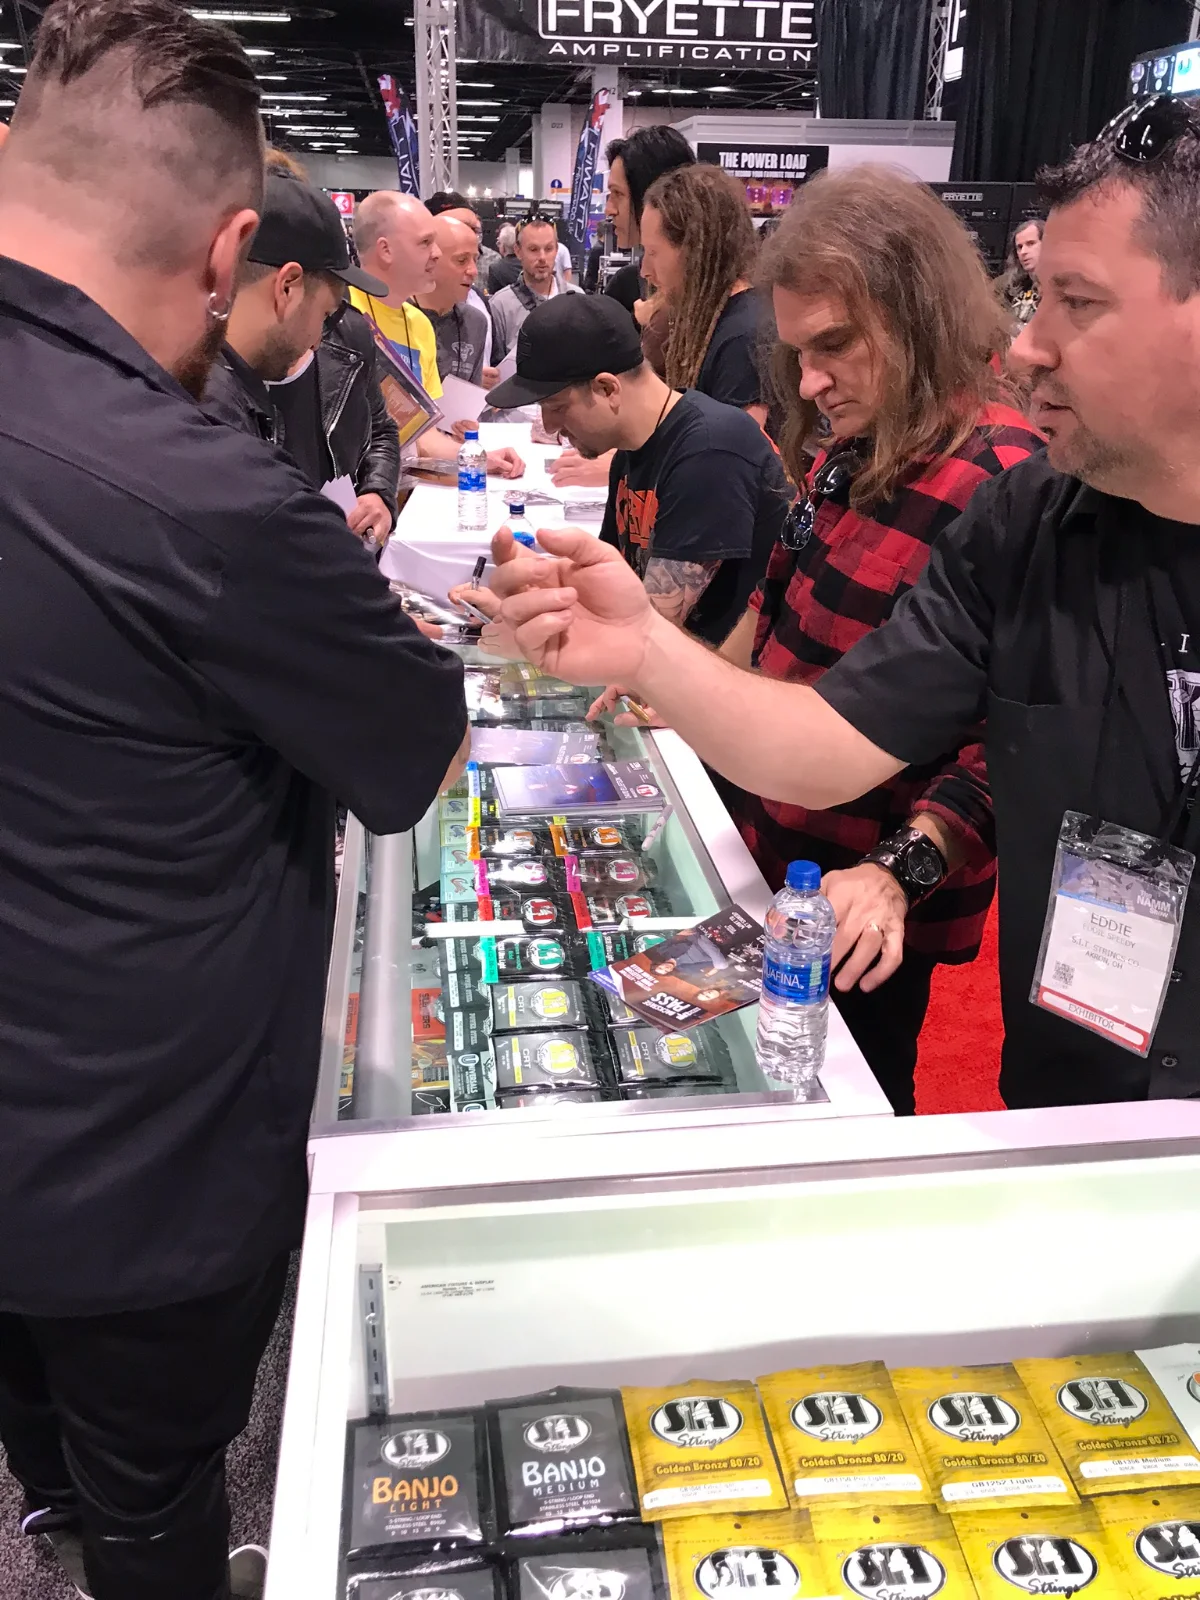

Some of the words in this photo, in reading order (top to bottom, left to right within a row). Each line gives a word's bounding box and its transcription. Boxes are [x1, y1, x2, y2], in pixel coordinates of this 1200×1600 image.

[547, 0, 815, 39] FRYETTE
[548, 42, 812, 62] AMPLIFICATION
[719, 152, 739, 168] THE
[741, 153, 777, 169] POWER
[780, 154, 807, 169] LOAD
[576, 142, 597, 230] HIWATT
[942, 193, 983, 201] FRYETTE
[1137, 895, 1171, 913] NAMM
[1090, 912, 1132, 938] EDDIE
[516, 995, 525, 1015] CRT
[650, 991, 691, 1013] PASS
[1068, 1003, 1115, 1031] EXHIBITOR
[522, 1048, 530, 1069] CRT
[640, 1041, 650, 1062] CRT
[1090, 1412, 1135, 1429] Strings
[677, 1432, 724, 1450] Strings
[819, 1427, 866, 1445] Strings
[958, 1428, 1005, 1446] Strings
[1078, 1438, 1113, 1451] Golden
[1114, 1436, 1148, 1449] Bronze
[1149, 1434, 1178, 1446] 80/20
[656, 1462, 691, 1476] Golden
[693, 1459, 728, 1472] Bronze
[730, 1456, 760, 1469] 80/20
[801, 1456, 836, 1468] Golden
[838, 1454, 873, 1466] Bronze
[874, 1452, 904, 1464] 80/20
[943, 1455, 978, 1468] Golden
[980, 1454, 1015, 1466] Bronze
[1016, 1452, 1046, 1464] 80/20
[521, 1456, 606, 1487] BANJO
[372, 1475, 459, 1504] BANJO
[533, 1479, 600, 1496] MEDIUM
[390, 1499, 442, 1513] LIGHT
[1028, 1578, 1081, 1599] Strings
